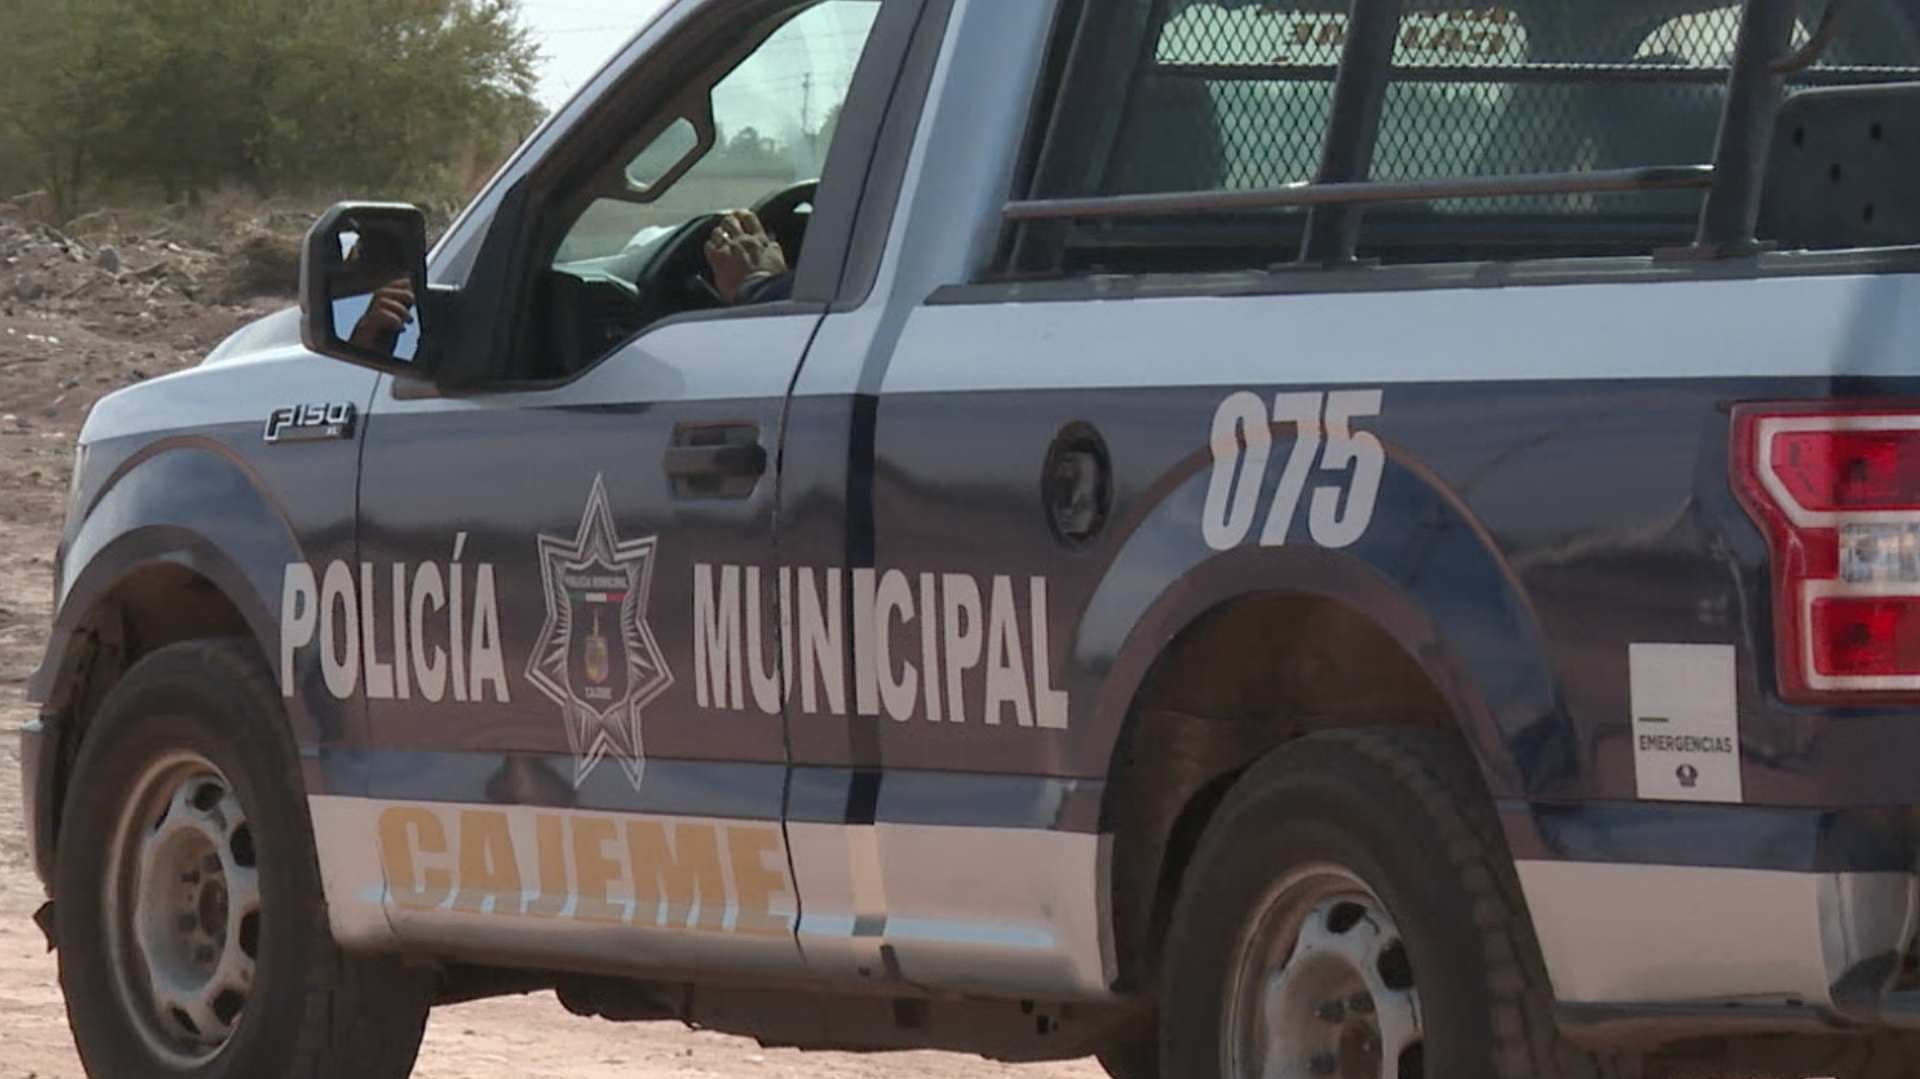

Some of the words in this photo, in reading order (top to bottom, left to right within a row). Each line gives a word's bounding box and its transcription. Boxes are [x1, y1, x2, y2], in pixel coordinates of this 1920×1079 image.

[1201, 389, 1385, 550] 075
[280, 531, 510, 703] POLICÍA
[693, 563, 1069, 729] MUNICIPAL
[1639, 735, 1732, 753] EMERGENCIAS
[379, 807, 796, 934] CAJEME
